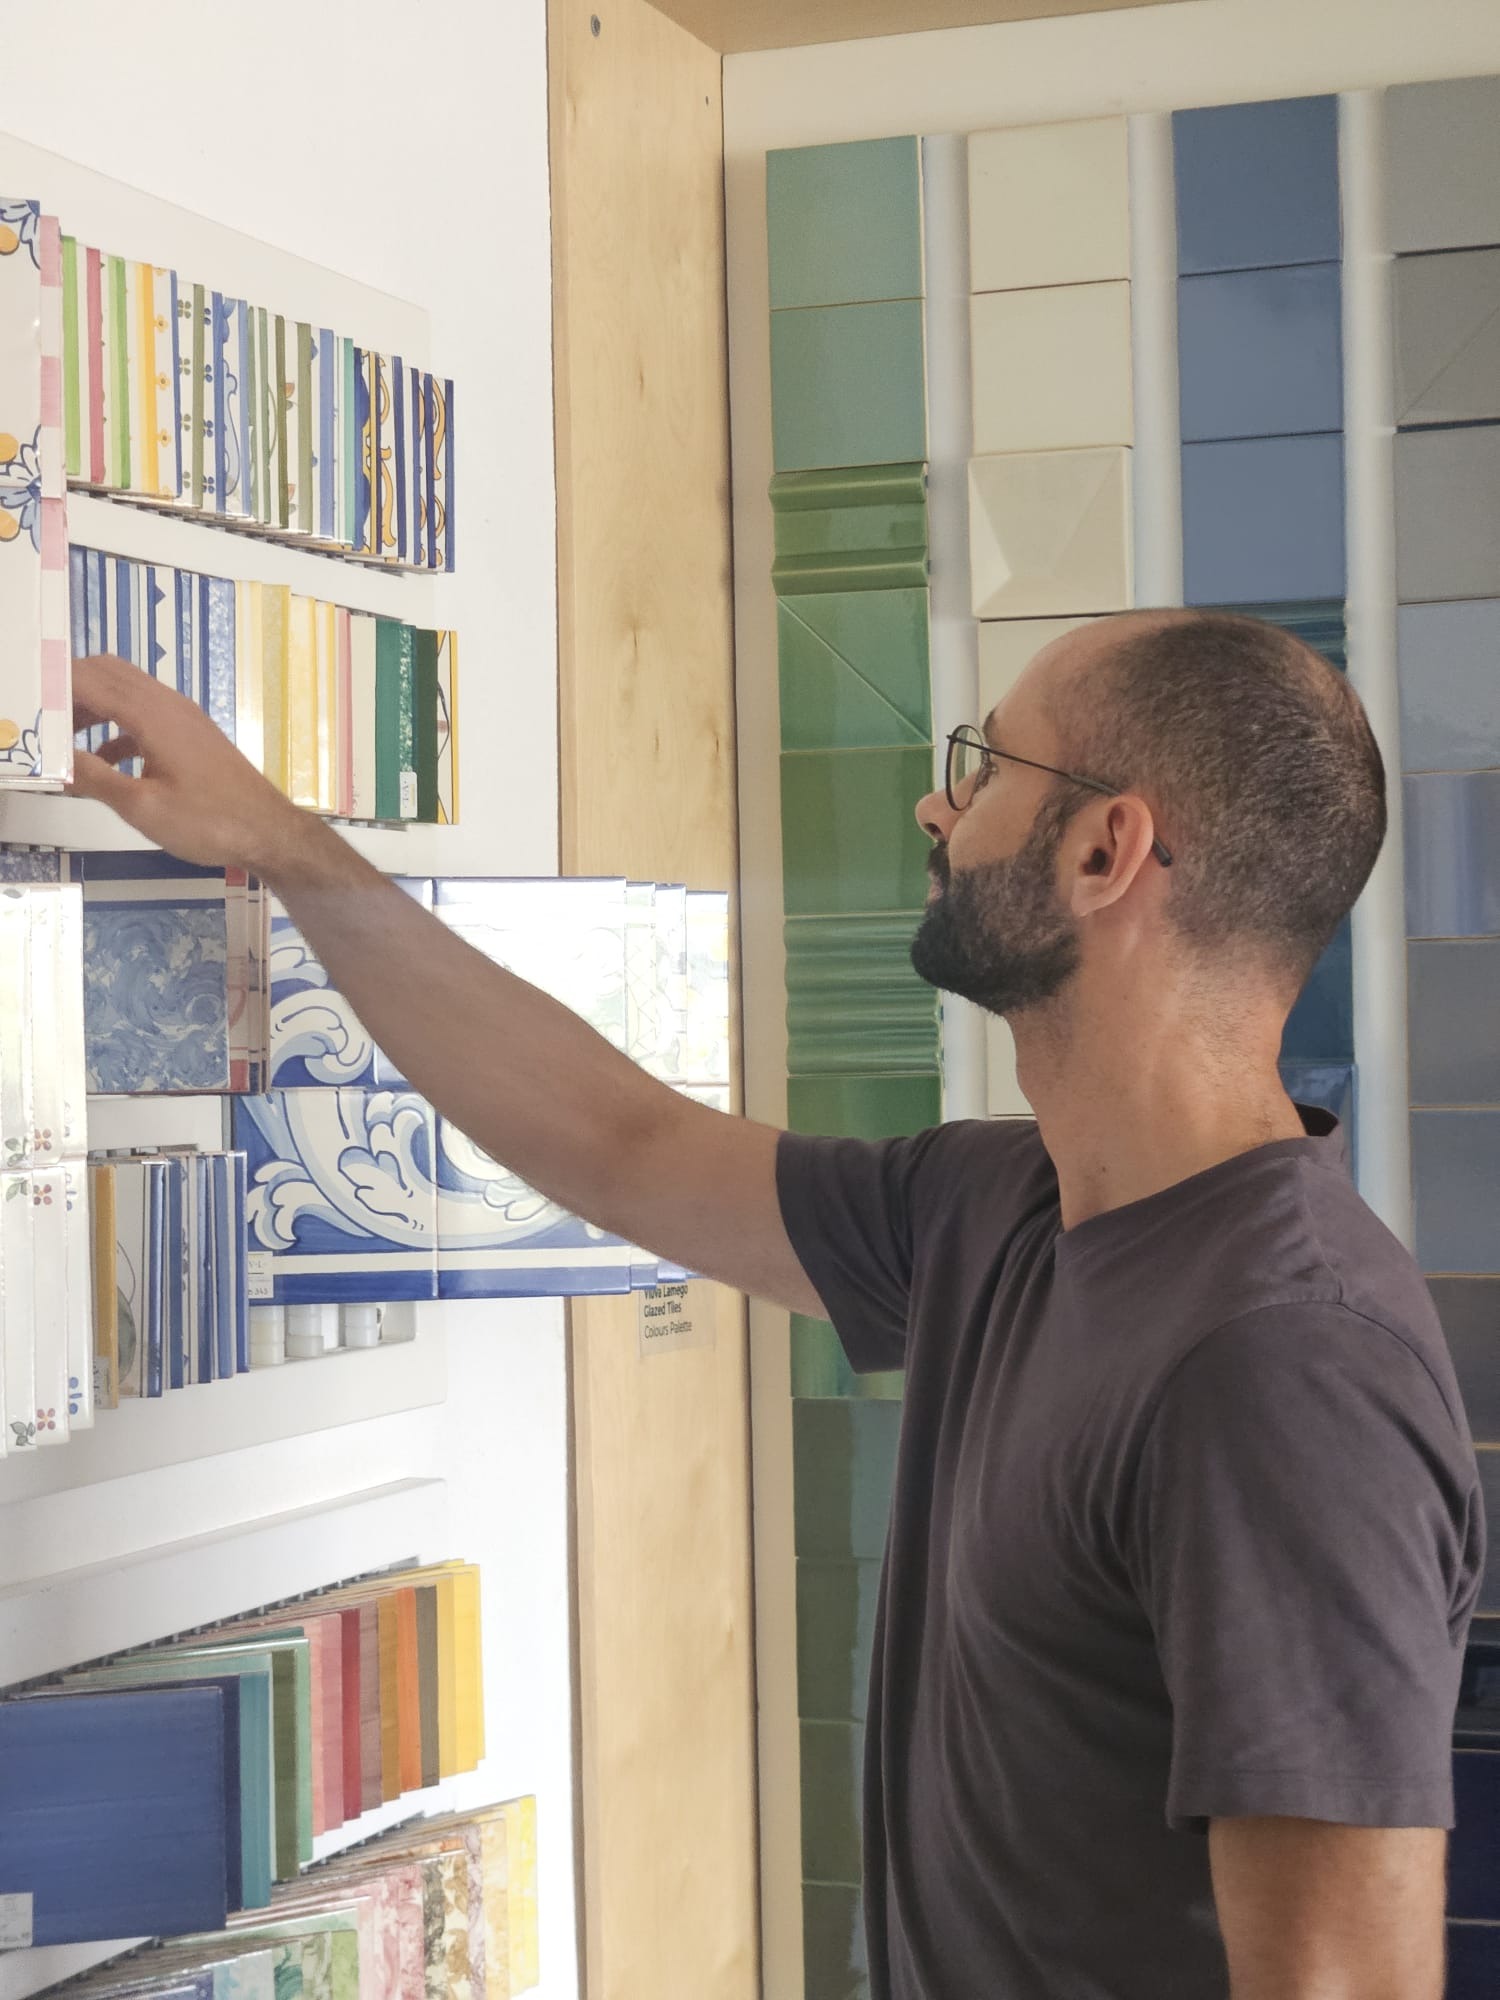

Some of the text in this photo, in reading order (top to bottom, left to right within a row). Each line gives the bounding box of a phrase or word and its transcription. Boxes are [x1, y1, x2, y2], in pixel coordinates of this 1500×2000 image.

[663, 1284, 688, 1299] Lamego
[644, 1300, 682, 1317] Glazed Tiles
[644, 1320, 692, 1339] Colours Palette
